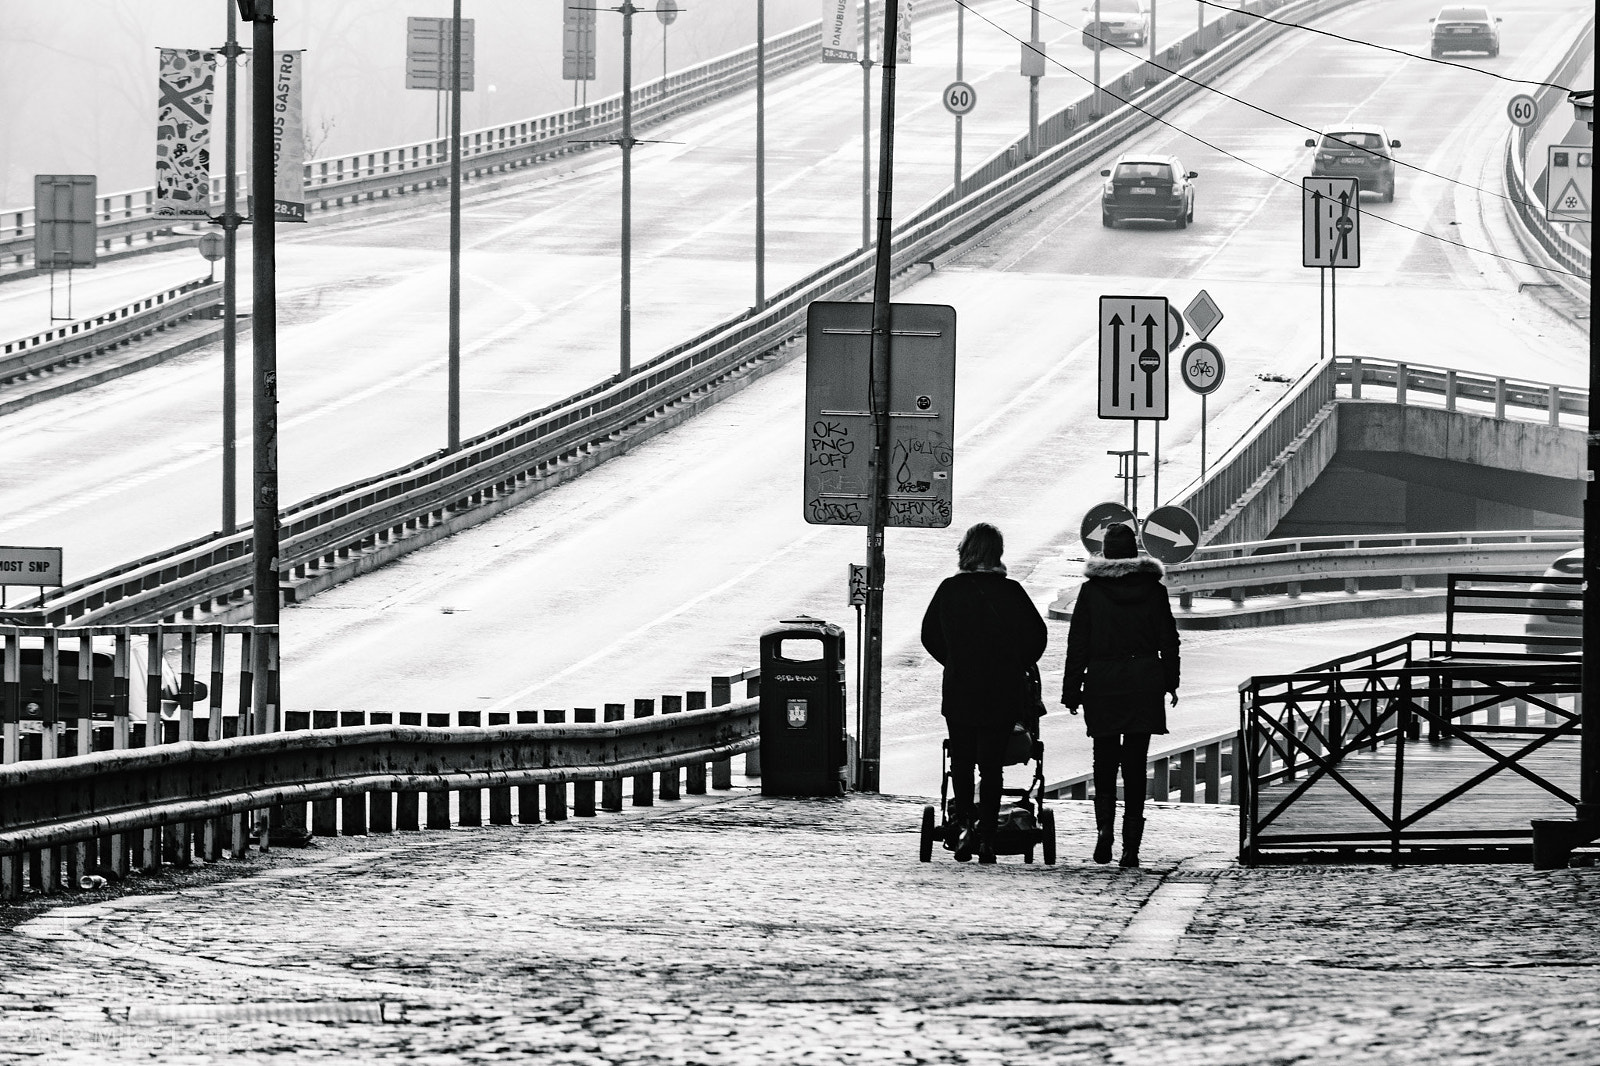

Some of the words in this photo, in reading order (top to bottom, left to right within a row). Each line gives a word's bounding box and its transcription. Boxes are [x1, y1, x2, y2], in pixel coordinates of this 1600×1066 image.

[275, 53, 295, 113] GASTRO
[950, 90, 969, 107] 60
[1514, 103, 1531, 119] 60
[813, 421, 848, 438] OK
[29, 561, 50, 572] SNP
